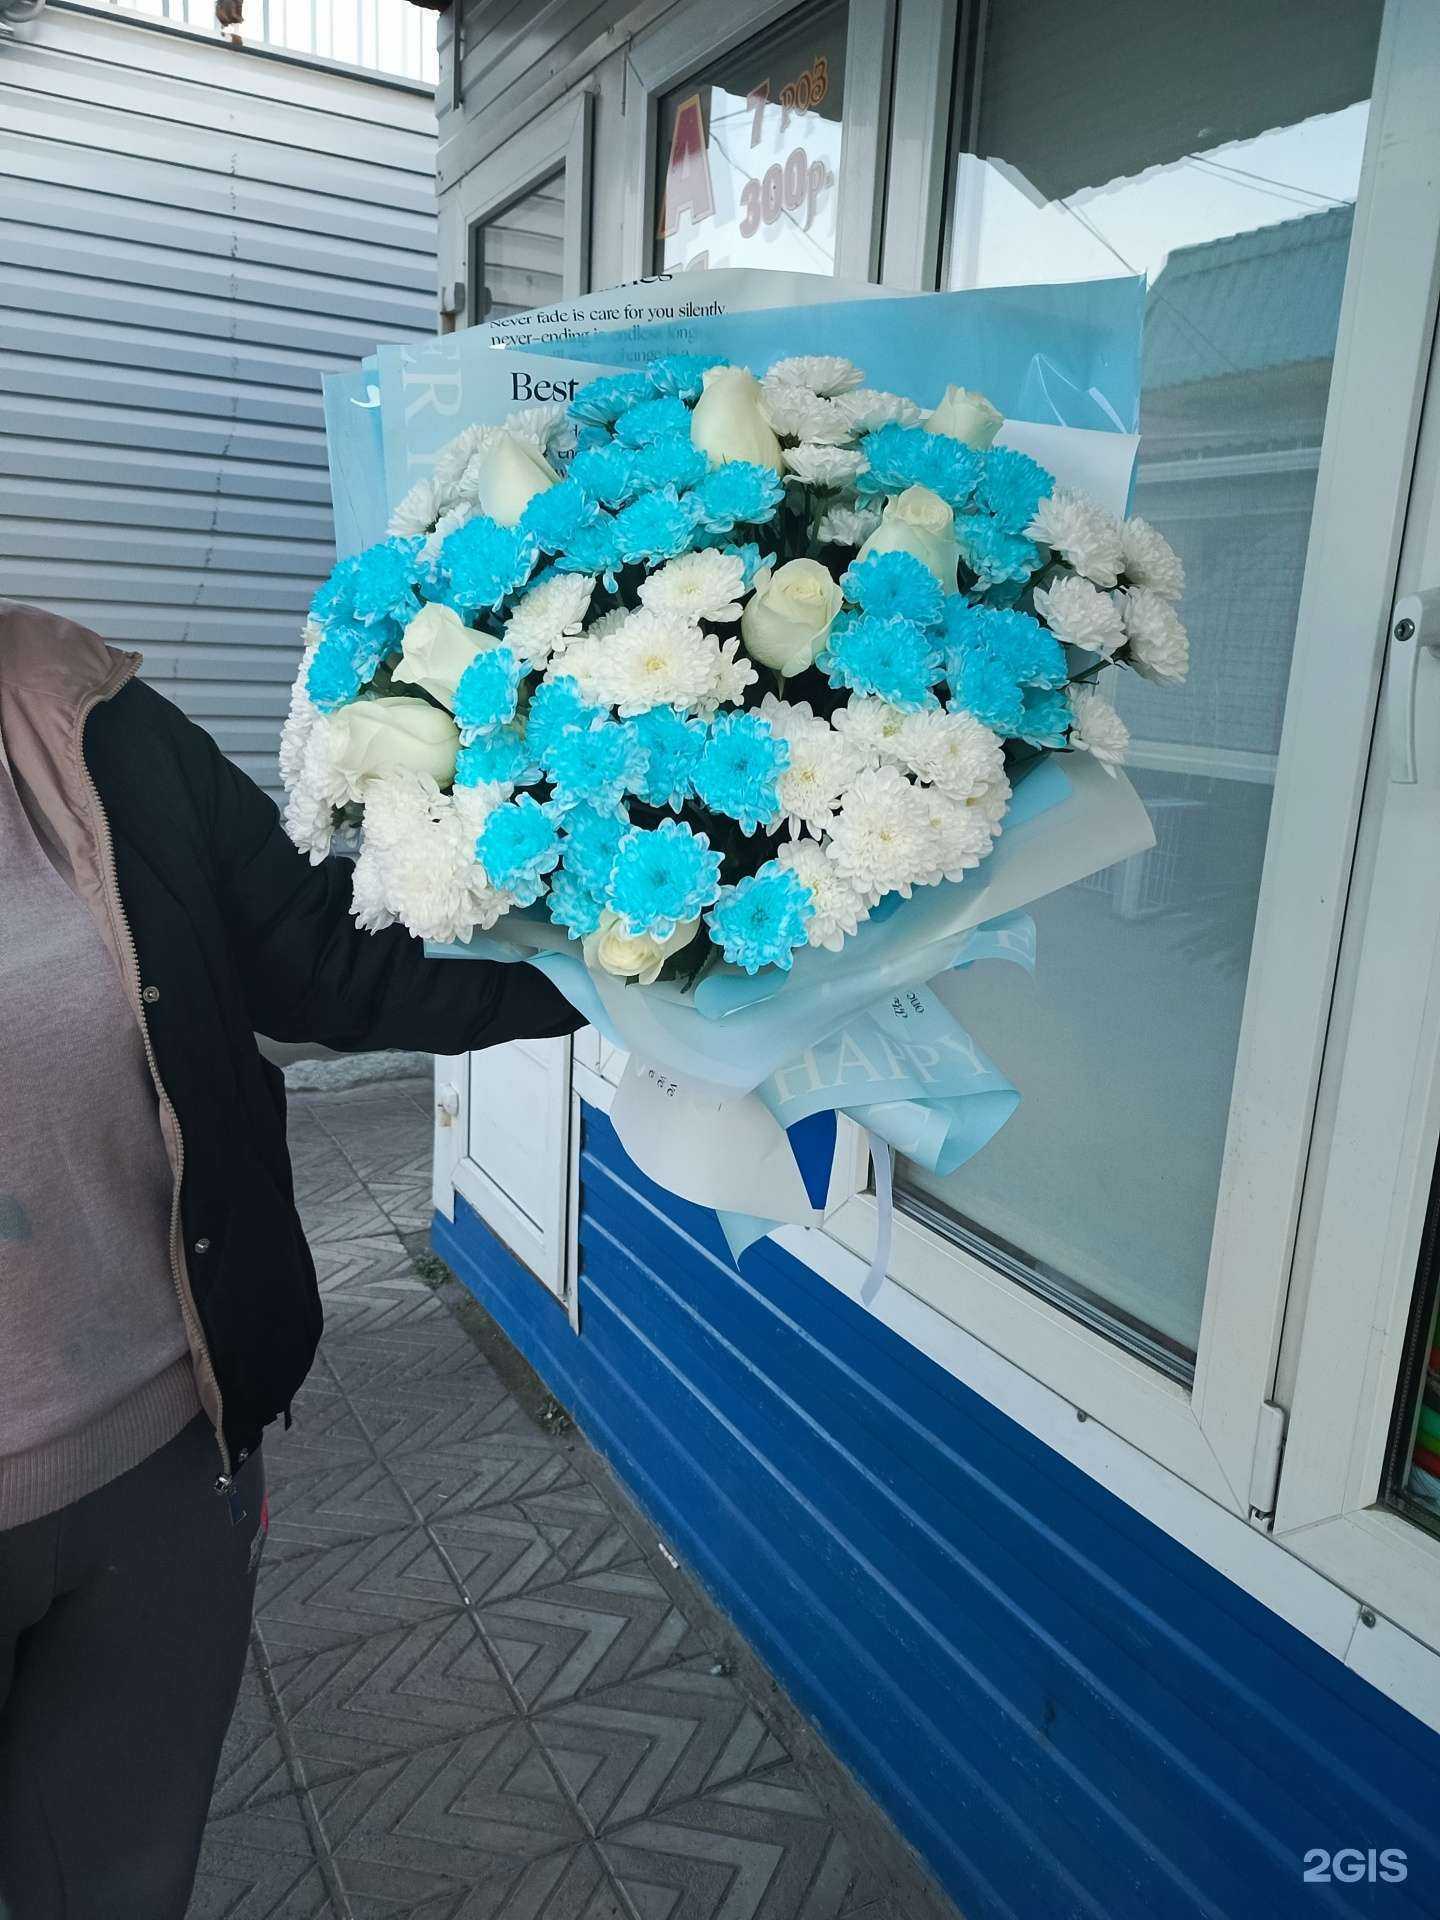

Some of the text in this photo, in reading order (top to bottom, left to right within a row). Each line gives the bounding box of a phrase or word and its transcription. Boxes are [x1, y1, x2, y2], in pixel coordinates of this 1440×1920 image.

[537, 309, 569, 324] fade
[572, 308, 585, 321] is
[589, 307, 620, 321] care
[624, 304, 644, 320] for
[648, 307, 674, 322] you
[678, 301, 726, 318] silently
[510, 372, 579, 402] Best
